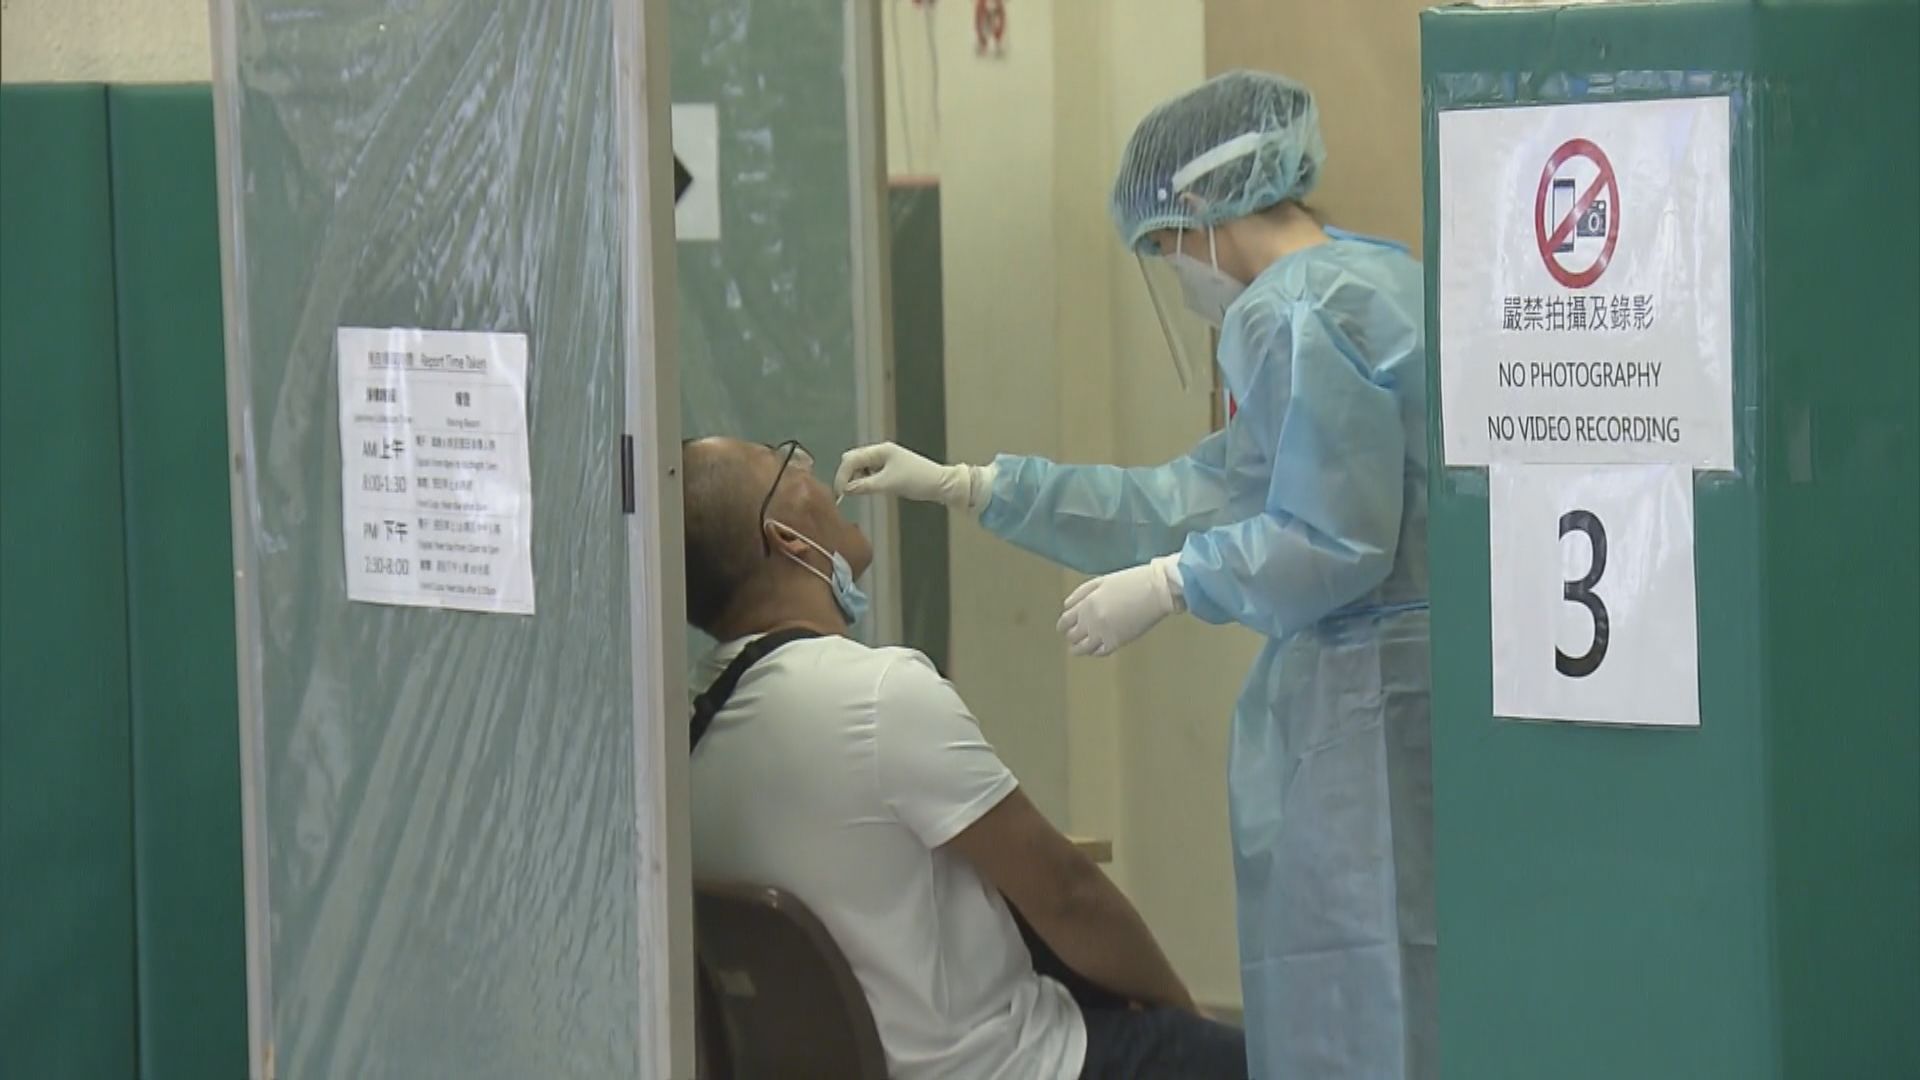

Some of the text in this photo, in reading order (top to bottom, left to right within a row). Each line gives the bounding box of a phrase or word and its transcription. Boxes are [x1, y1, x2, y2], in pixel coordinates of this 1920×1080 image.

[1502, 293, 1654, 332] 嚴禁拍攝及錄影
[1499, 361, 1662, 388] NO PHOTOGRAPHY
[1487, 415, 1680, 443] NO VIDEO RECORDING
[362, 440, 377, 458] AM
[379, 437, 405, 460] 上午
[363, 522, 378, 540] PM
[383, 519, 409, 542] 下午
[1555, 509, 1610, 678] 3
